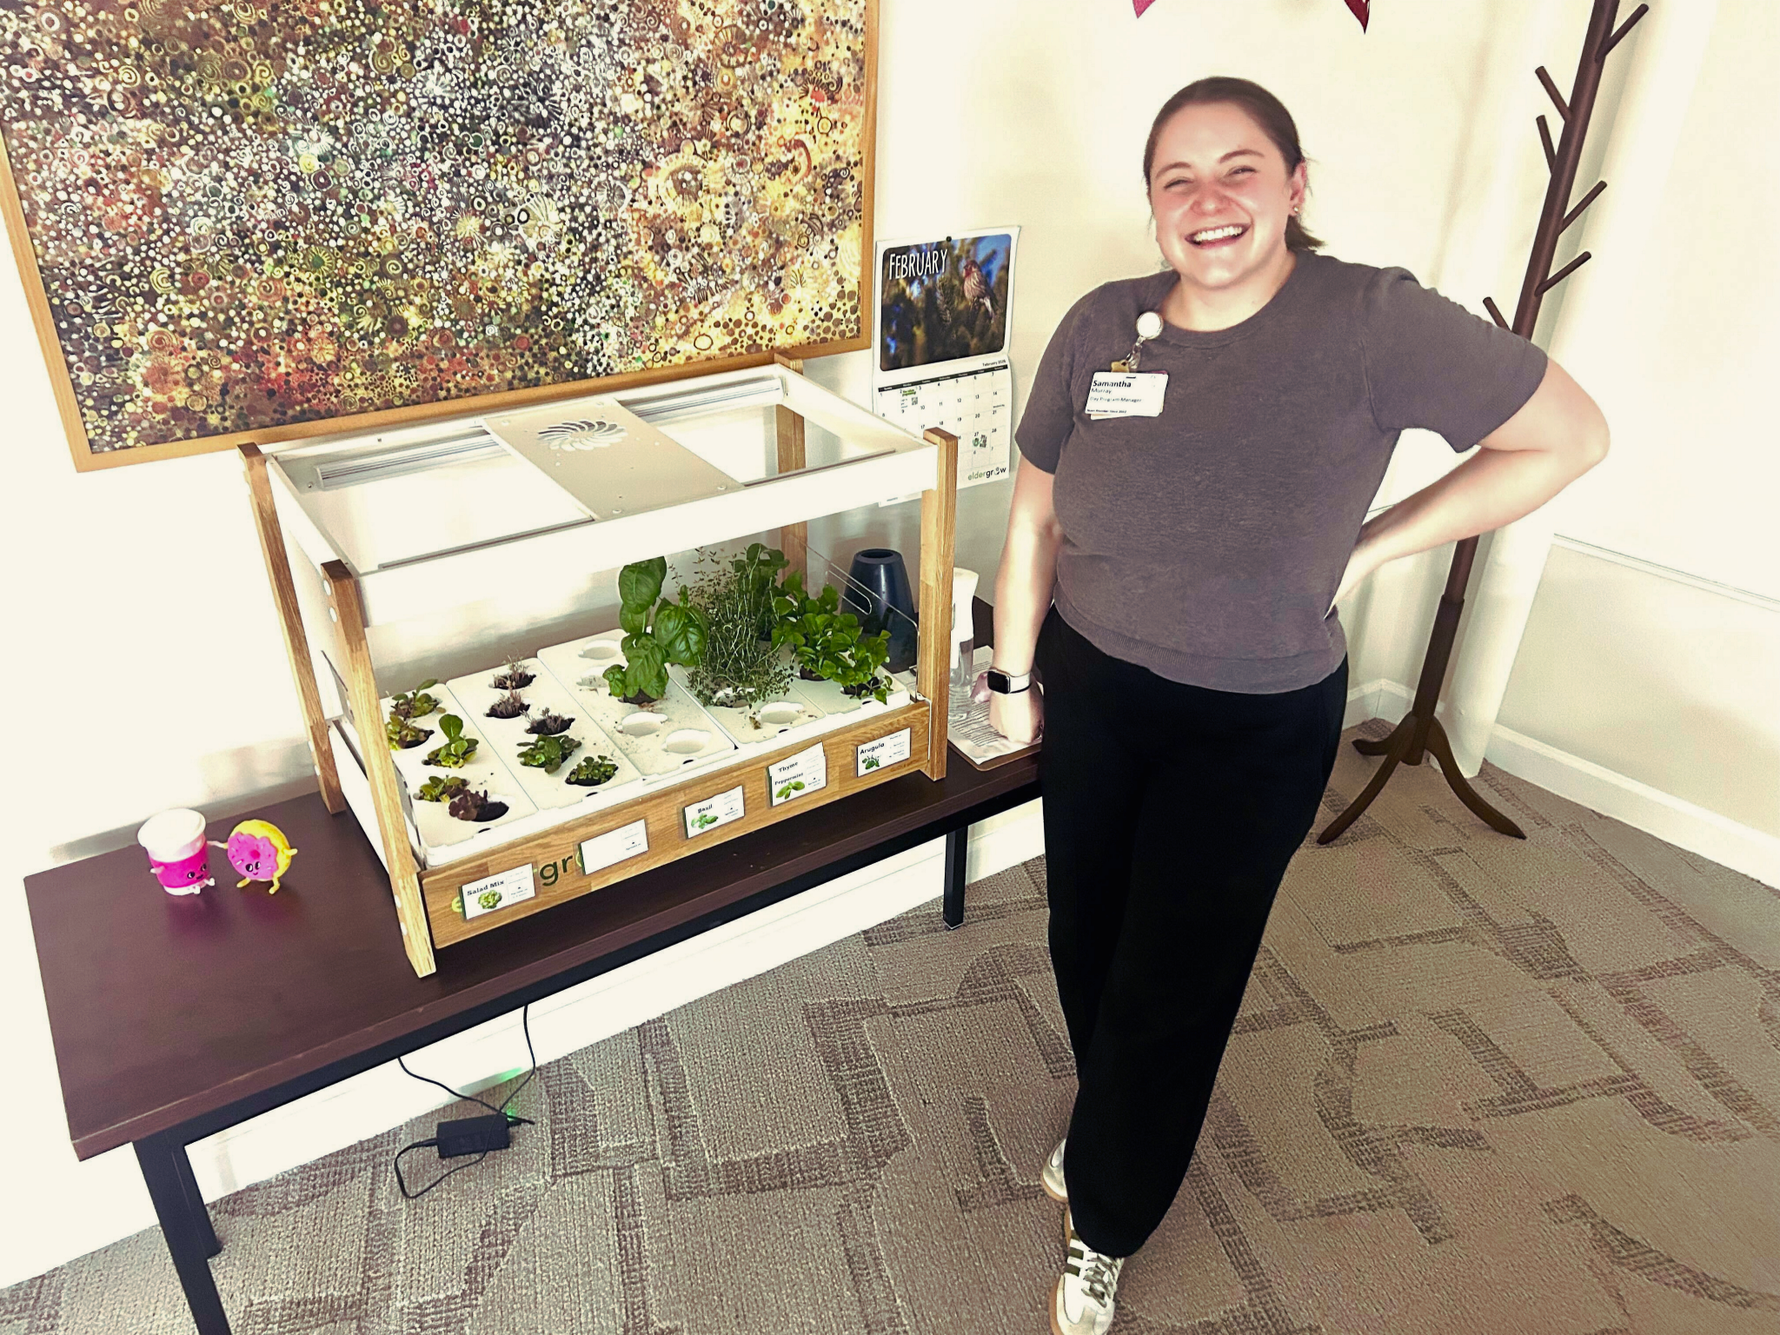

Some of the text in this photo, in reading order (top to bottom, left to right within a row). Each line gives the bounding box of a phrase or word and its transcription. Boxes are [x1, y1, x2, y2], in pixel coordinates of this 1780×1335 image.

[889, 249, 948, 280] FEBRUARY
[1093, 380, 1132, 388] Samantha
[860, 742, 885, 755] Arugula
[778, 762, 798, 773] Thyme
[774, 772, 804, 786] Peppermint
[697, 804, 713, 813] Basil
[467, 880, 505, 896] Salad Mix
